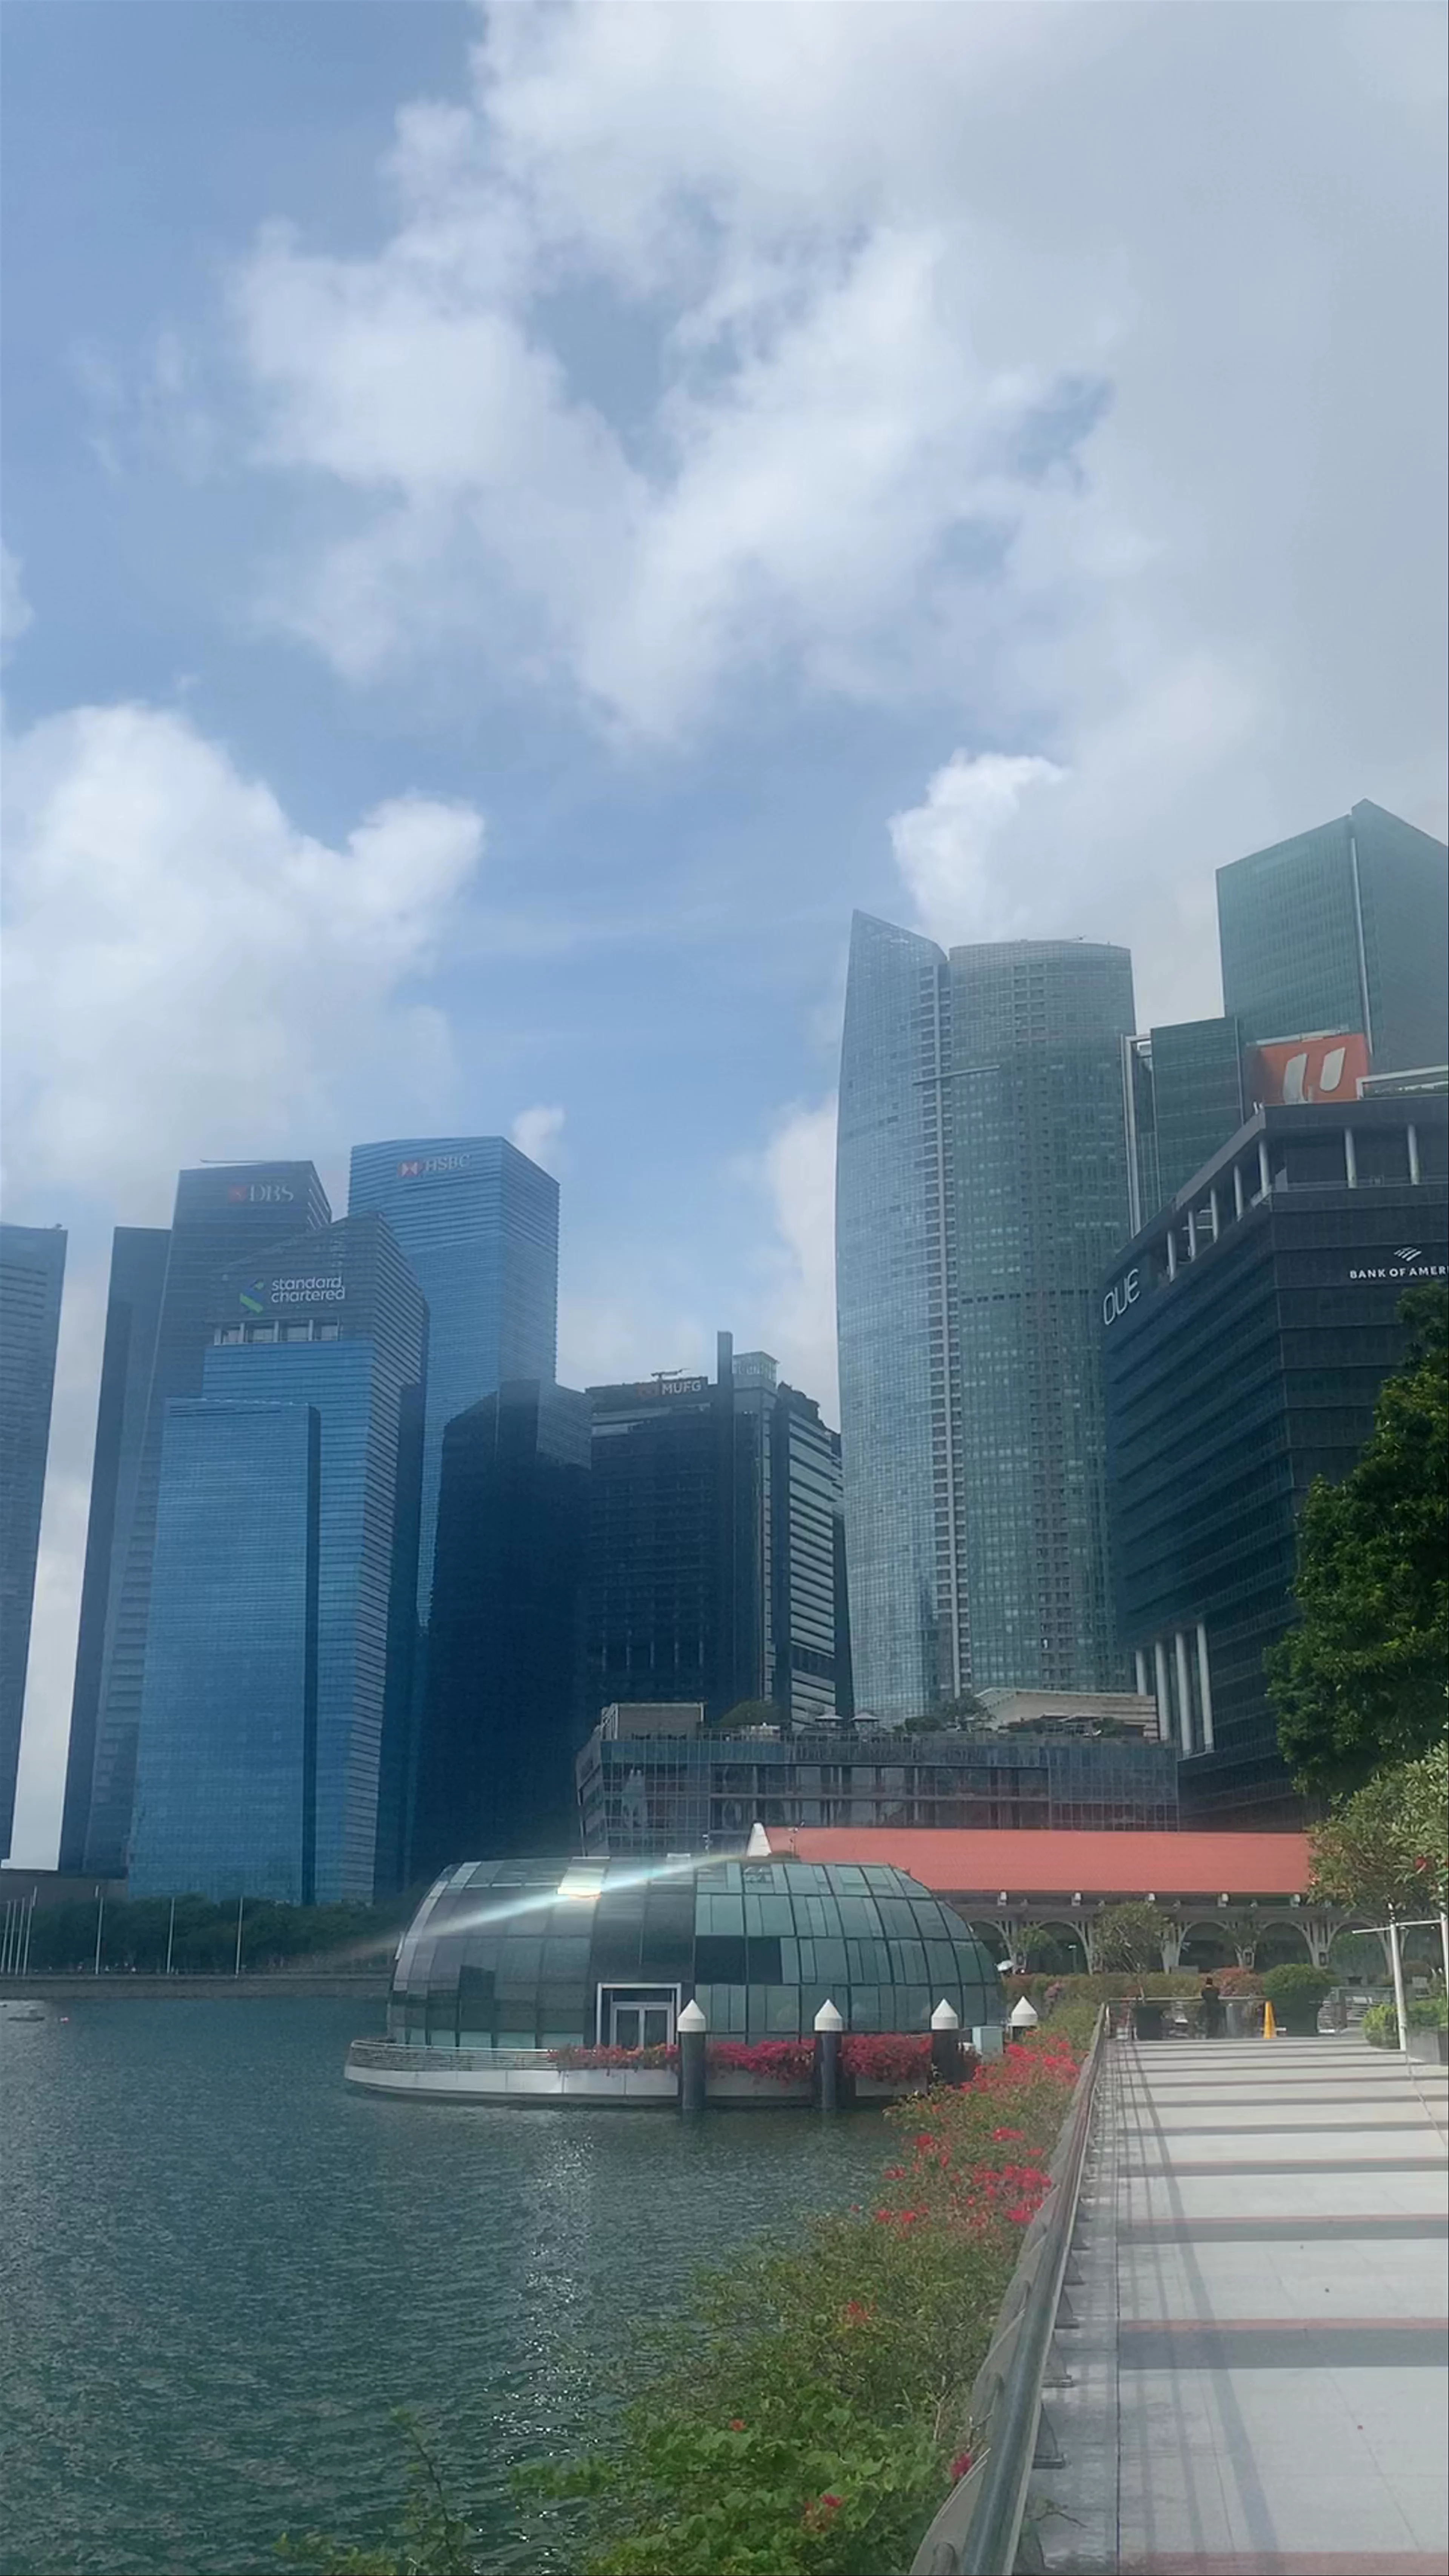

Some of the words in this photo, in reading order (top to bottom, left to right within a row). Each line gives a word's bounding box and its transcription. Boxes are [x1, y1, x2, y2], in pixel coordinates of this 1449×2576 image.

[426, 1153, 470, 1171] HSBC
[249, 1184, 294, 1202] DBS
[1349, 1269, 1386, 1279] BANK
[1389, 1268, 1406, 1277] OF
[272, 1276, 341, 1291] standard
[271, 1286, 345, 1303] chartered
[1103, 1268, 1140, 1326] OUE
[662, 1380, 701, 1395] MUFG
